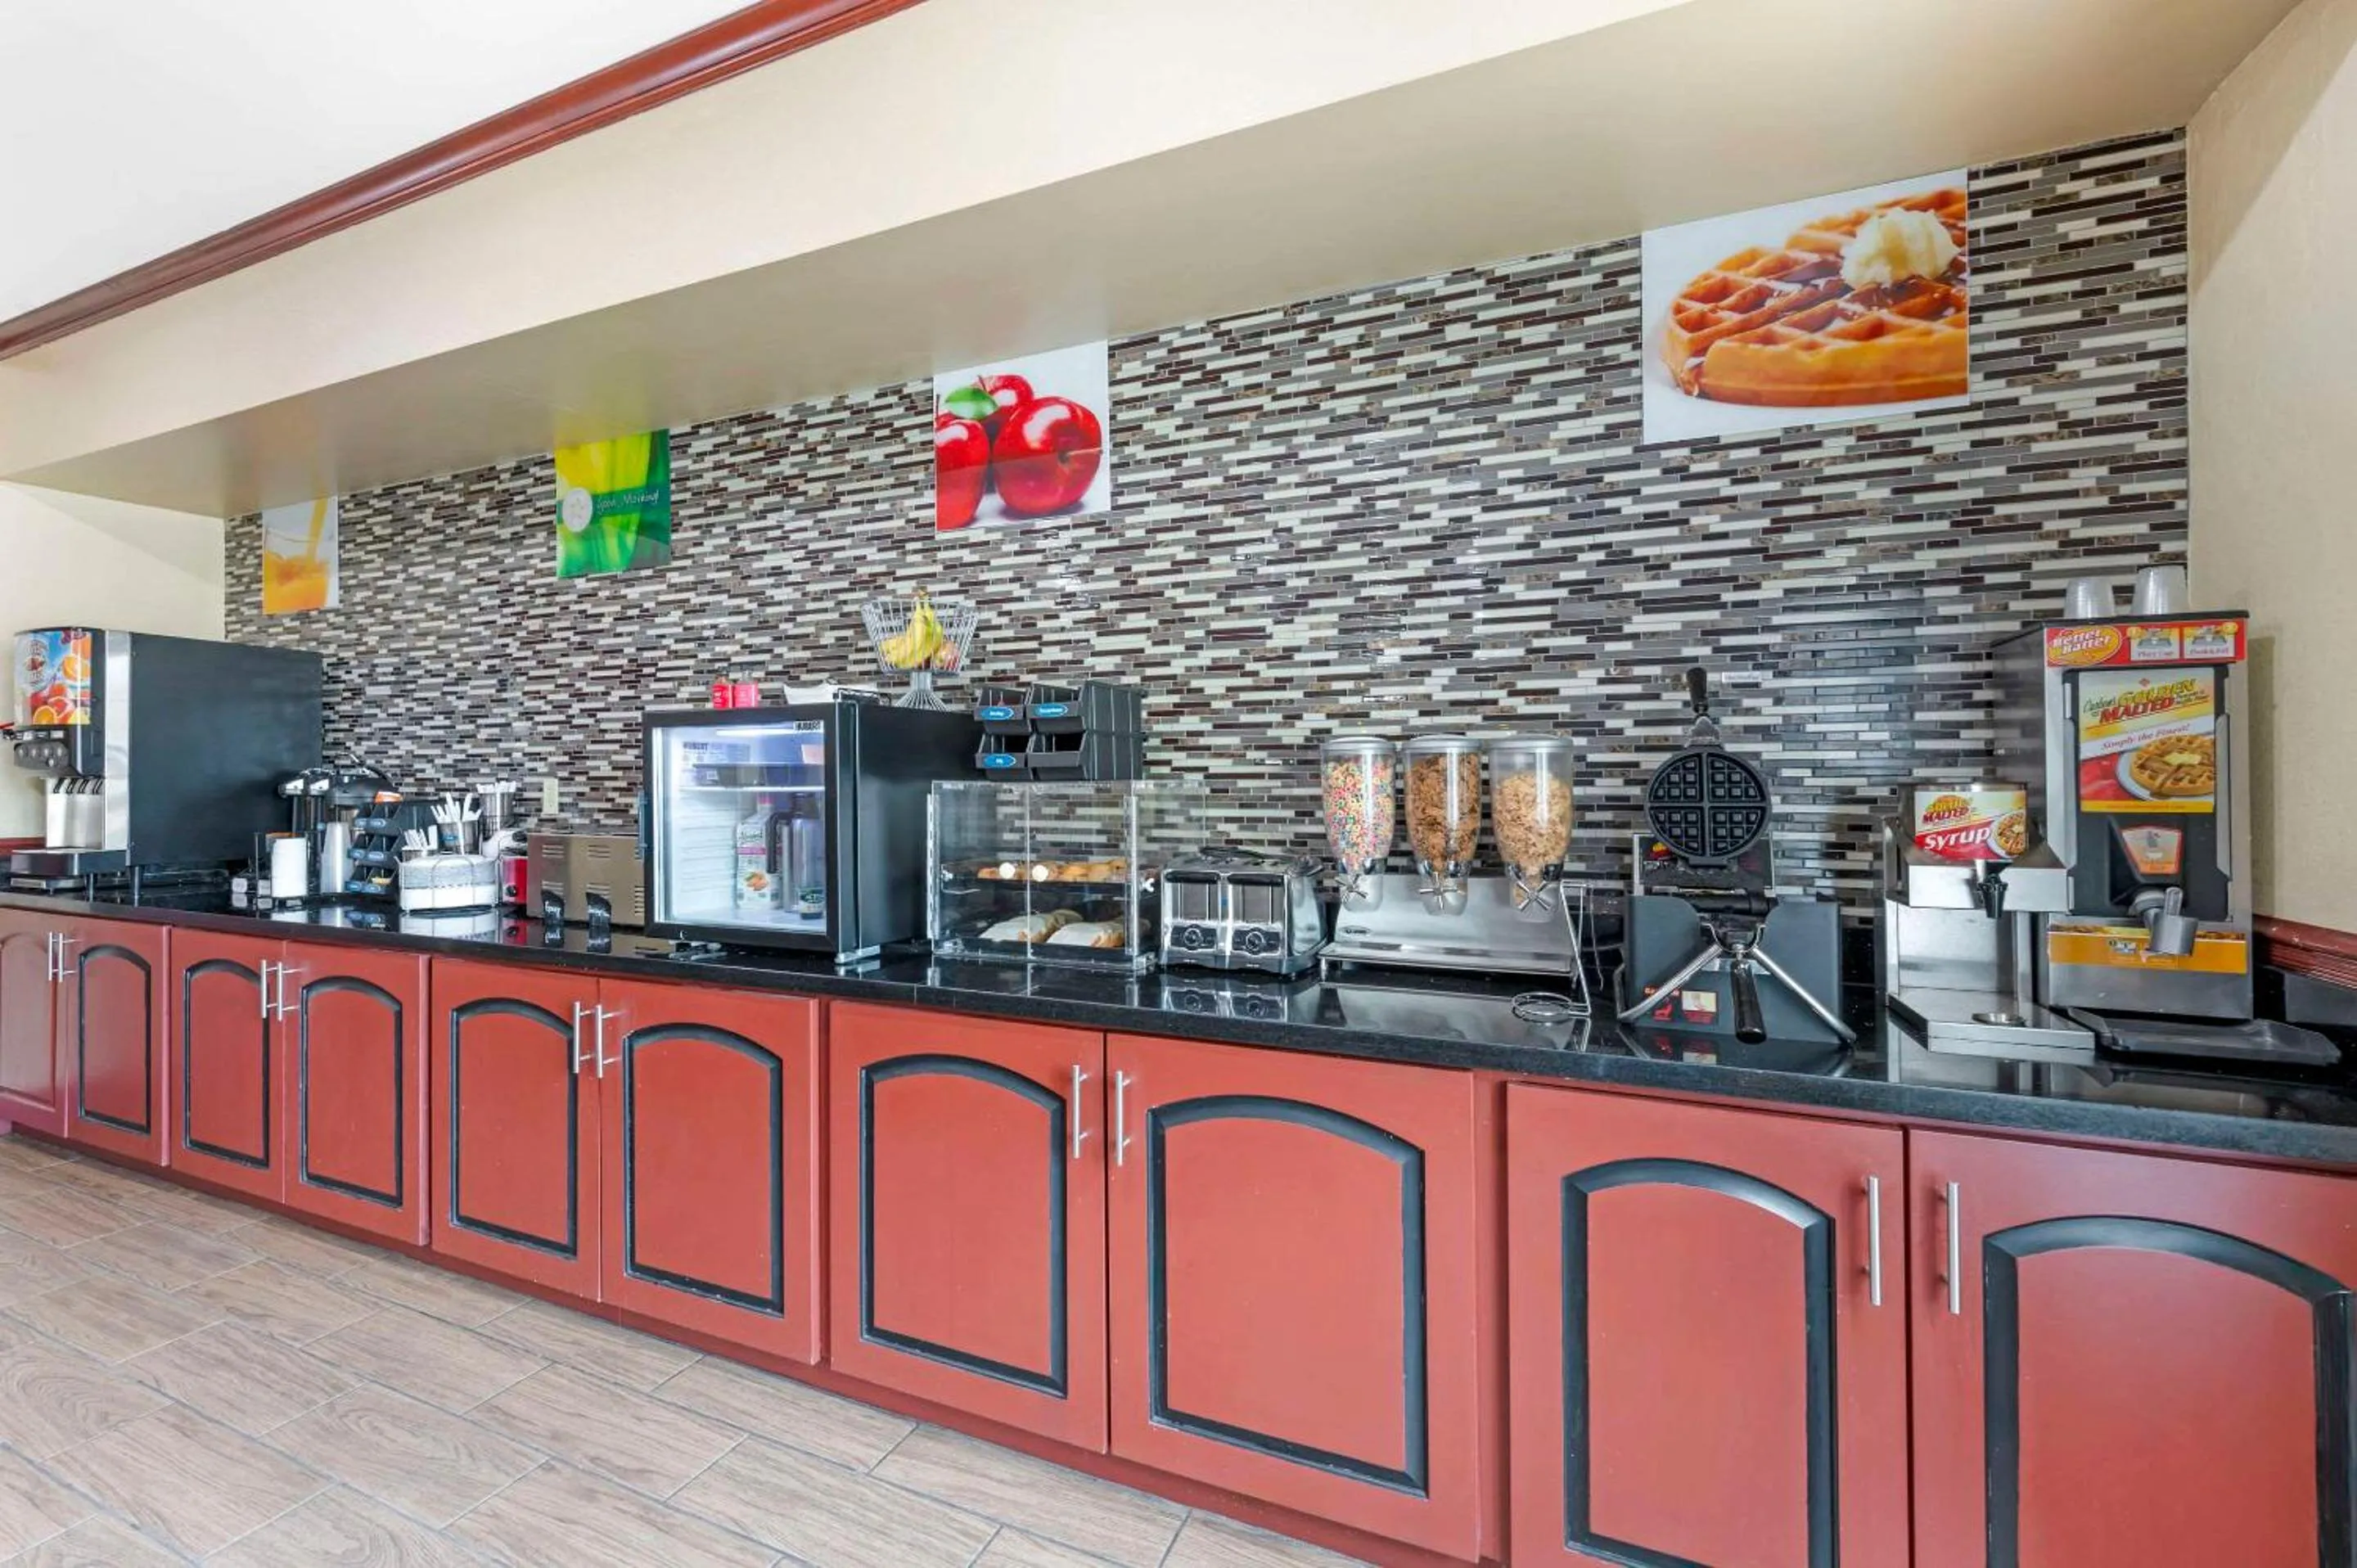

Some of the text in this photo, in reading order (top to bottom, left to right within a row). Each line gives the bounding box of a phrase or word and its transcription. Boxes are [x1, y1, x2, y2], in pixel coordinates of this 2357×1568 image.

[2099, 696, 2175, 723] MALTED
[2138, 732, 2154, 741] the
[1924, 827, 1990, 850] Syrup
